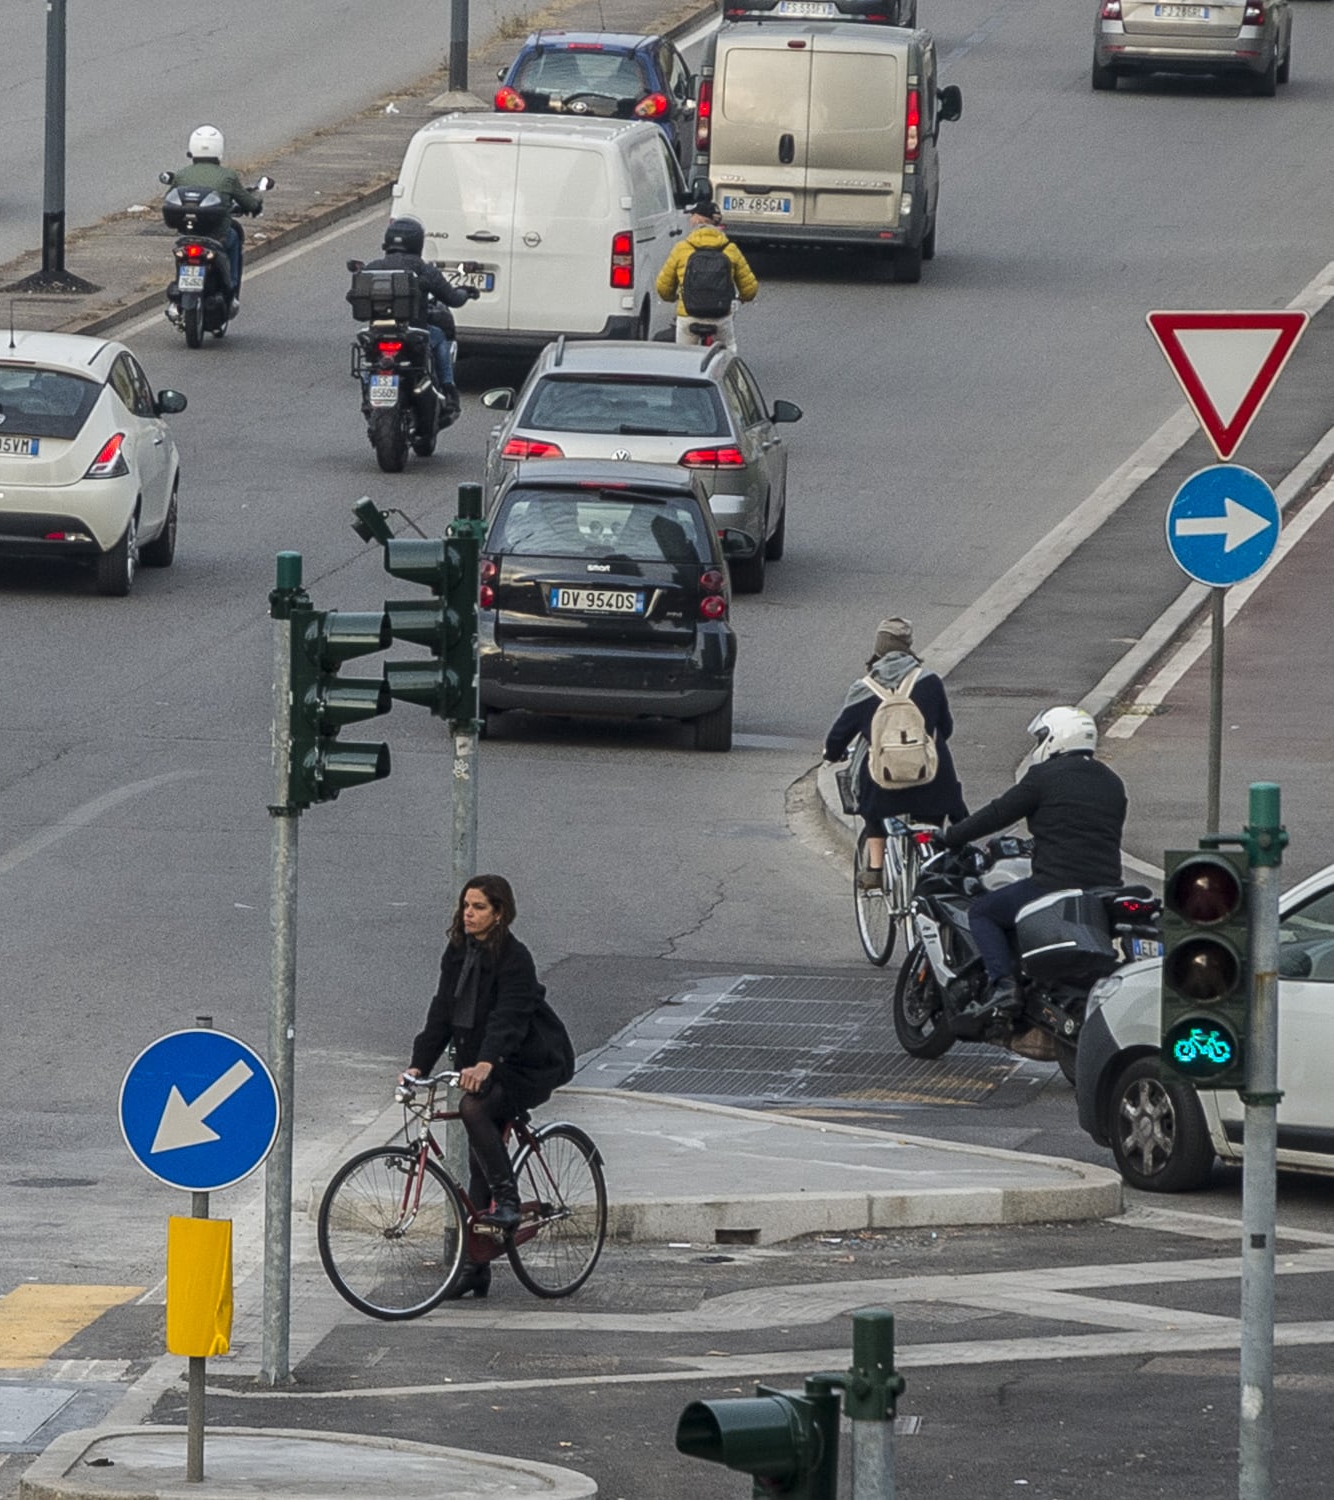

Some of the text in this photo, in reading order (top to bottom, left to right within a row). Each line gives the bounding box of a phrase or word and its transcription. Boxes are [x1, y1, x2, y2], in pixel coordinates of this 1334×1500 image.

[731, 198, 745, 210] DR
[561, 591, 634, 610] DV 954DS
